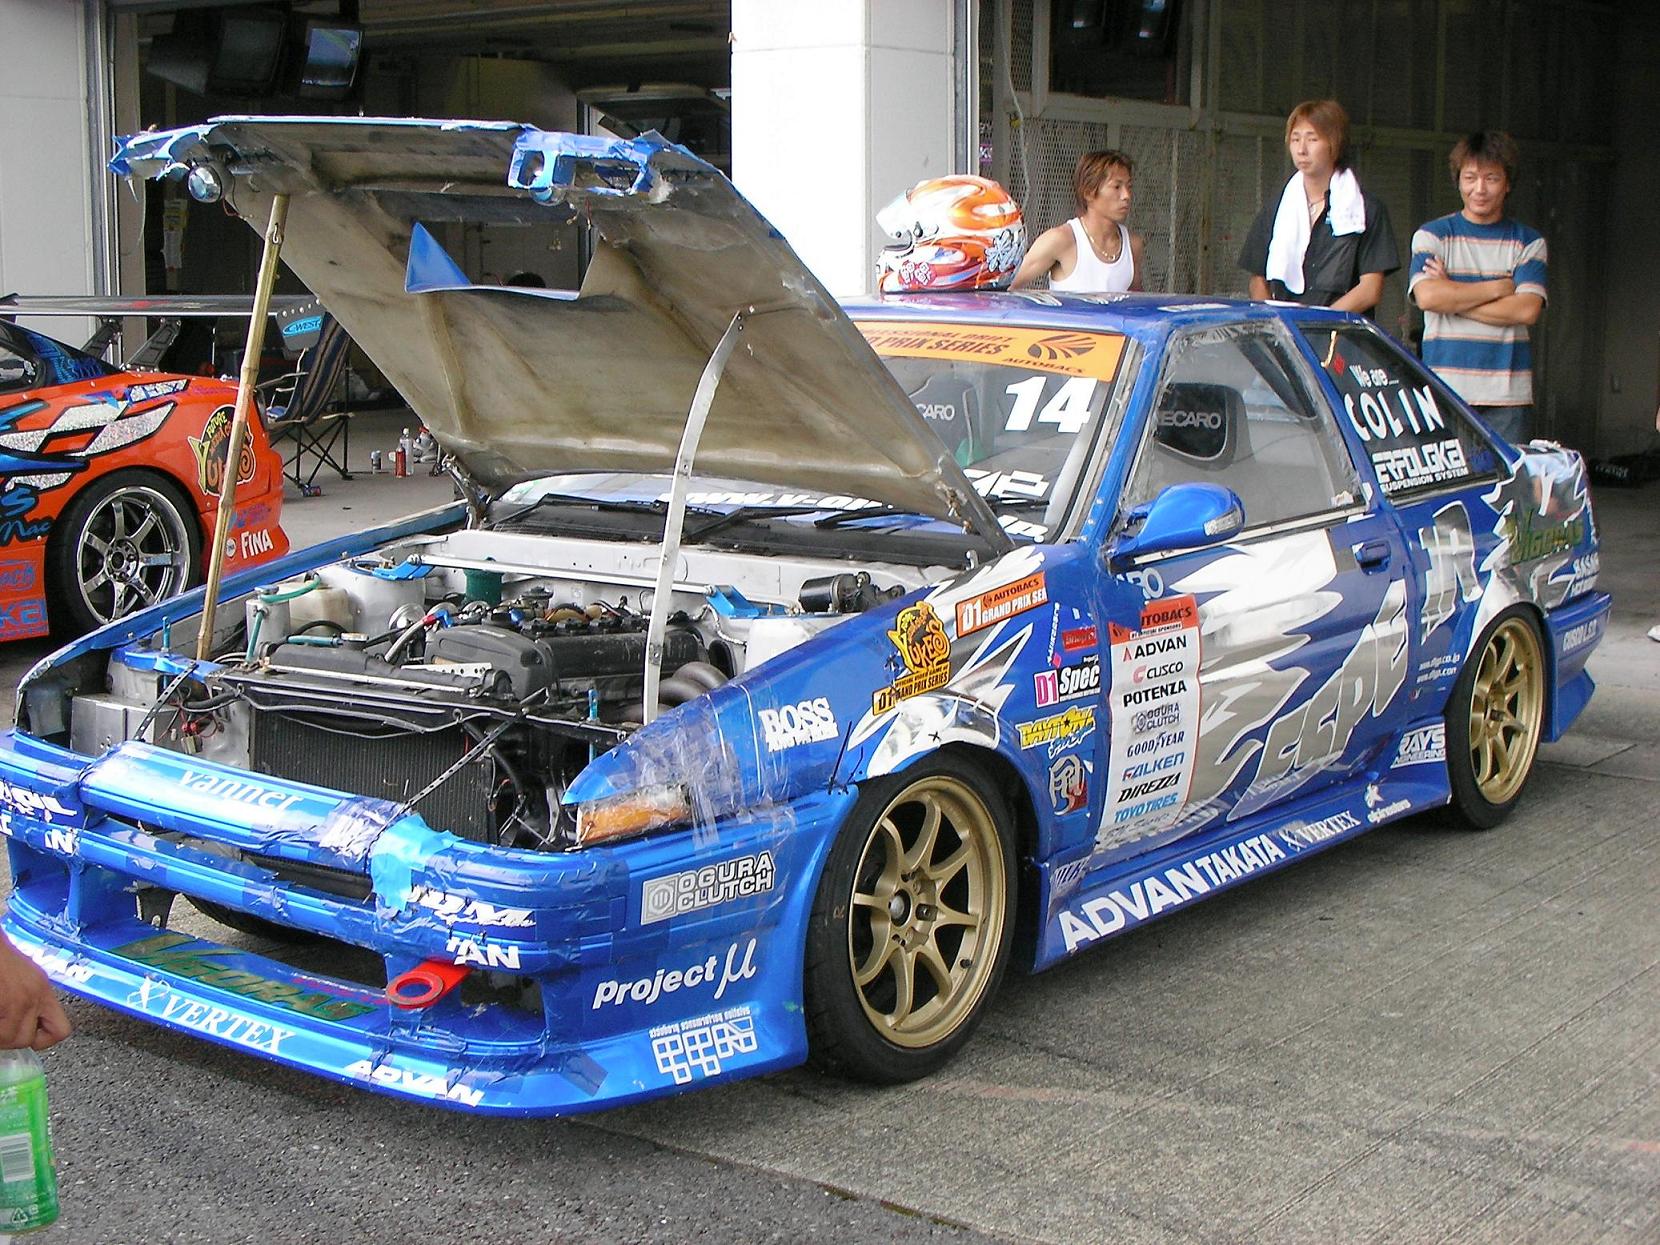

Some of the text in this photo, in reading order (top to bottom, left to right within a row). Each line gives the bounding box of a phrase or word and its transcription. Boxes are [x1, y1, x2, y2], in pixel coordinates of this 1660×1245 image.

[927, 340, 1011, 355] SERIES
[1002, 357, 1084, 374] AUTOBACS
[1349, 365, 1372, 388] We
[915, 404, 955, 421] CARO
[1005, 376, 1098, 433] 14
[1344, 385, 1445, 442] COLIN
[1380, 467, 1469, 493] SUSPENSION SYSTEM
[241, 529, 274, 560] FINA
[993, 578, 1040, 602] AUTOBACS
[982, 601, 1011, 624] GRAND
[1012, 593, 1032, 613] PRIX
[1134, 635, 1188, 660] ADVAN
[928, 672, 948, 687] SERIES
[1036, 674, 1058, 705] D1
[1059, 665, 1100, 695] Spec
[1146, 661, 1184, 680] CUSCO
[1123, 680, 1188, 708] POTENZA
[758, 696, 834, 736] BOSS
[1146, 702, 1180, 719] OGURA
[1146, 713, 1180, 731] CLUTCH
[1020, 709, 1095, 749] DAYTONA
[1122, 752, 1185, 782] FALKEN
[179, 769, 304, 812] vanner
[1117, 772, 1182, 804] DIREZZA
[1297, 810, 1362, 844] VERTEX
[677, 850, 776, 893] OGURA
[1196, 827, 1287, 887] TAKATA
[676, 870, 774, 914] CLUTCH
[1058, 863, 1211, 952] ADVAN
[592, 955, 718, 1010] Project
[157, 996, 296, 1053] VERTEX
[342, 1059, 486, 1108] ADVAN
